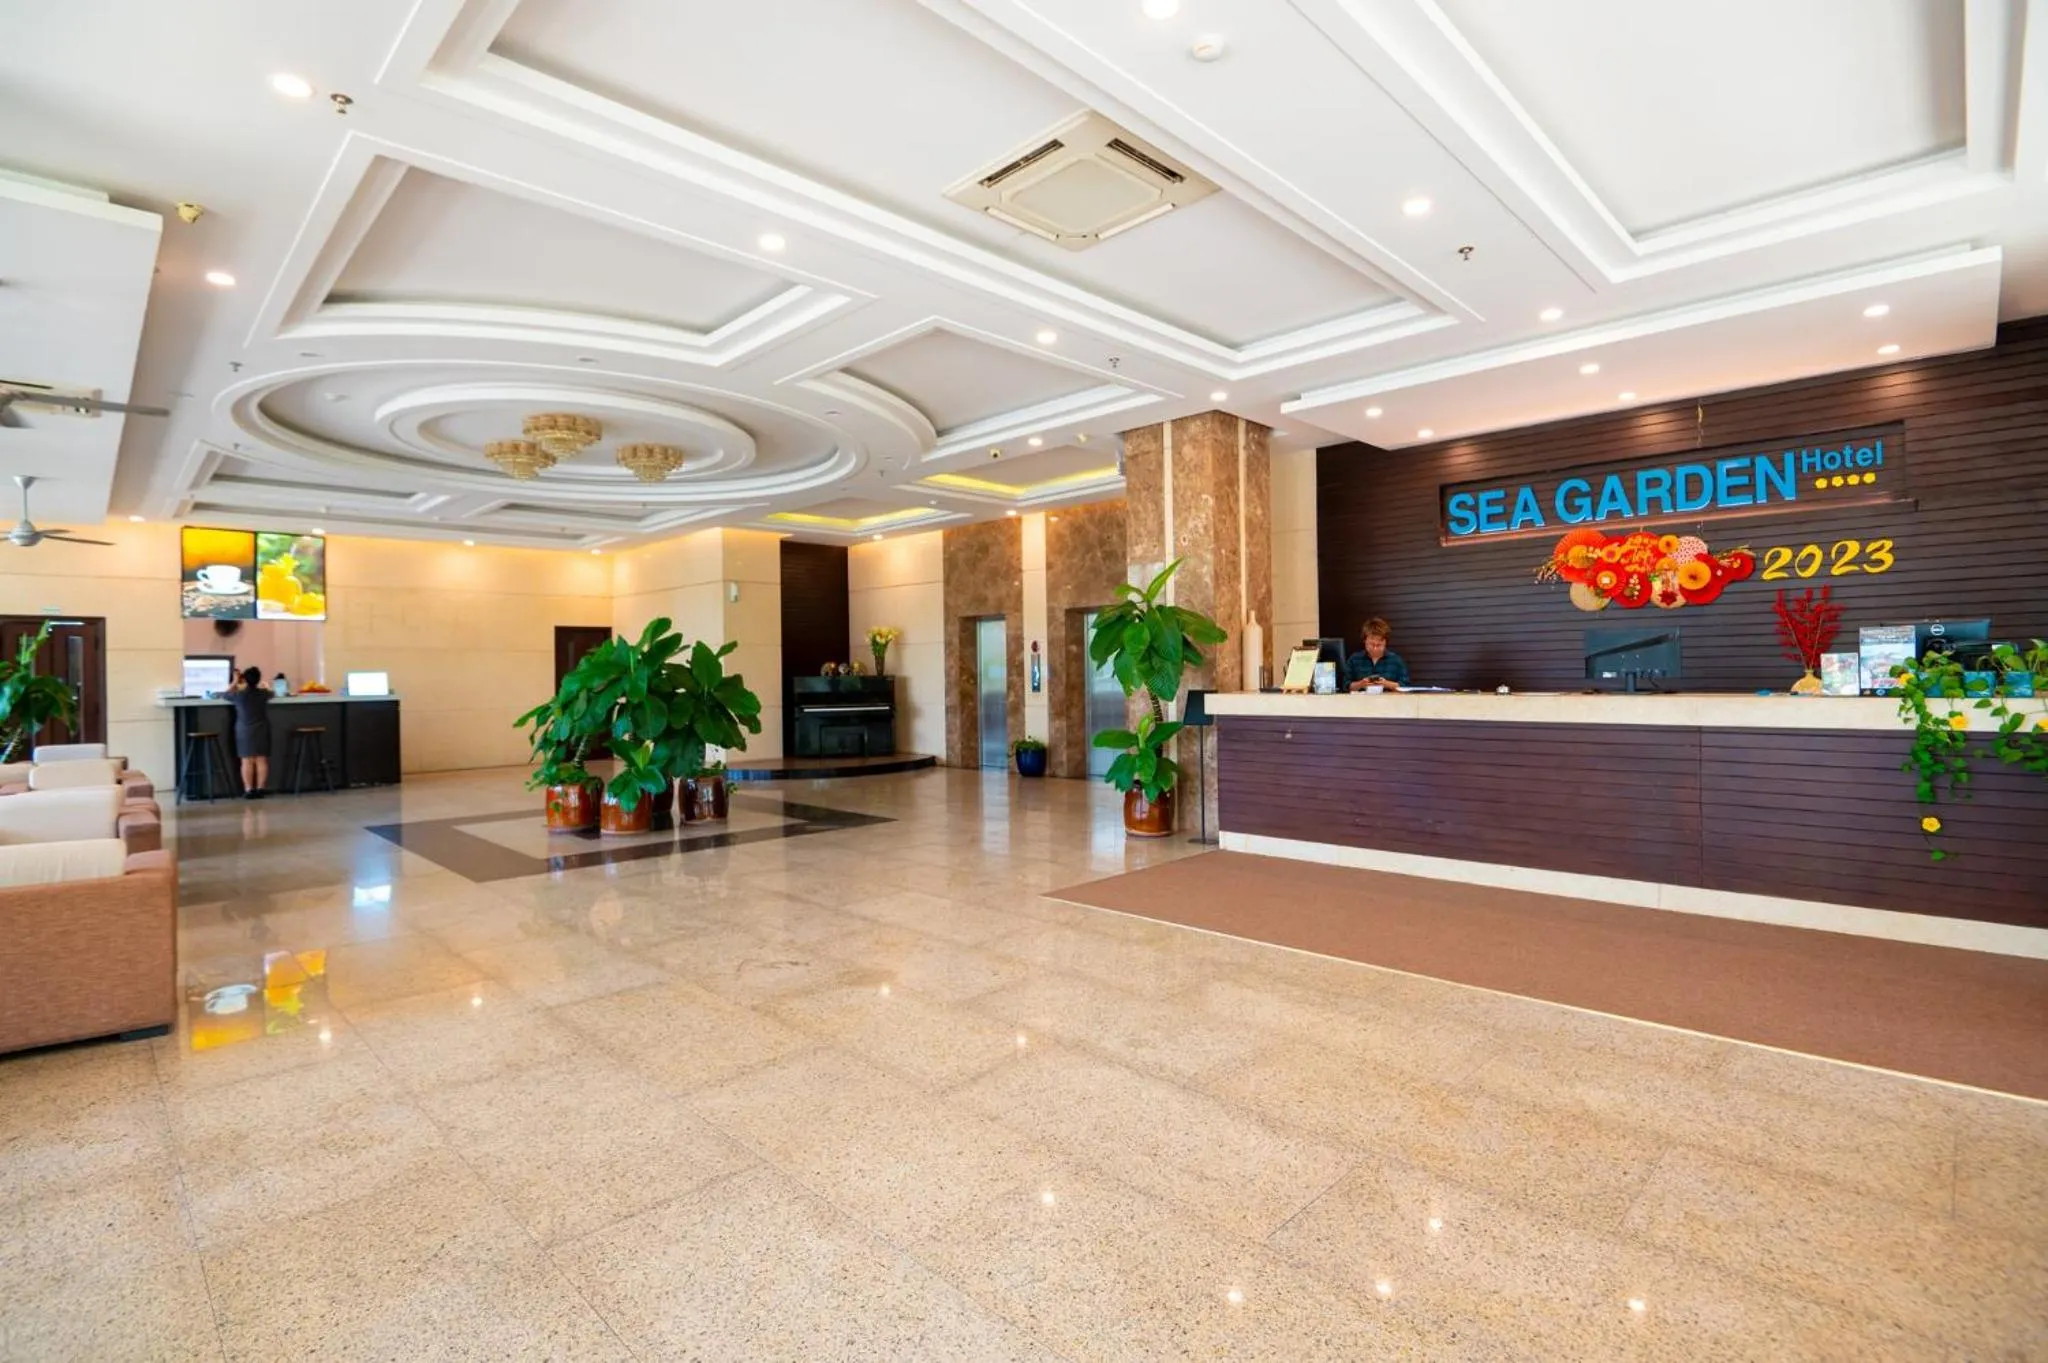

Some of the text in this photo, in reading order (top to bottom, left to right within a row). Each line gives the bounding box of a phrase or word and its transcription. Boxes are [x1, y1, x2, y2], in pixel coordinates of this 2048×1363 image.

[1448, 440, 1883, 535] SEA GARDEN Hotel
[1761, 539, 1895, 580] 2023
